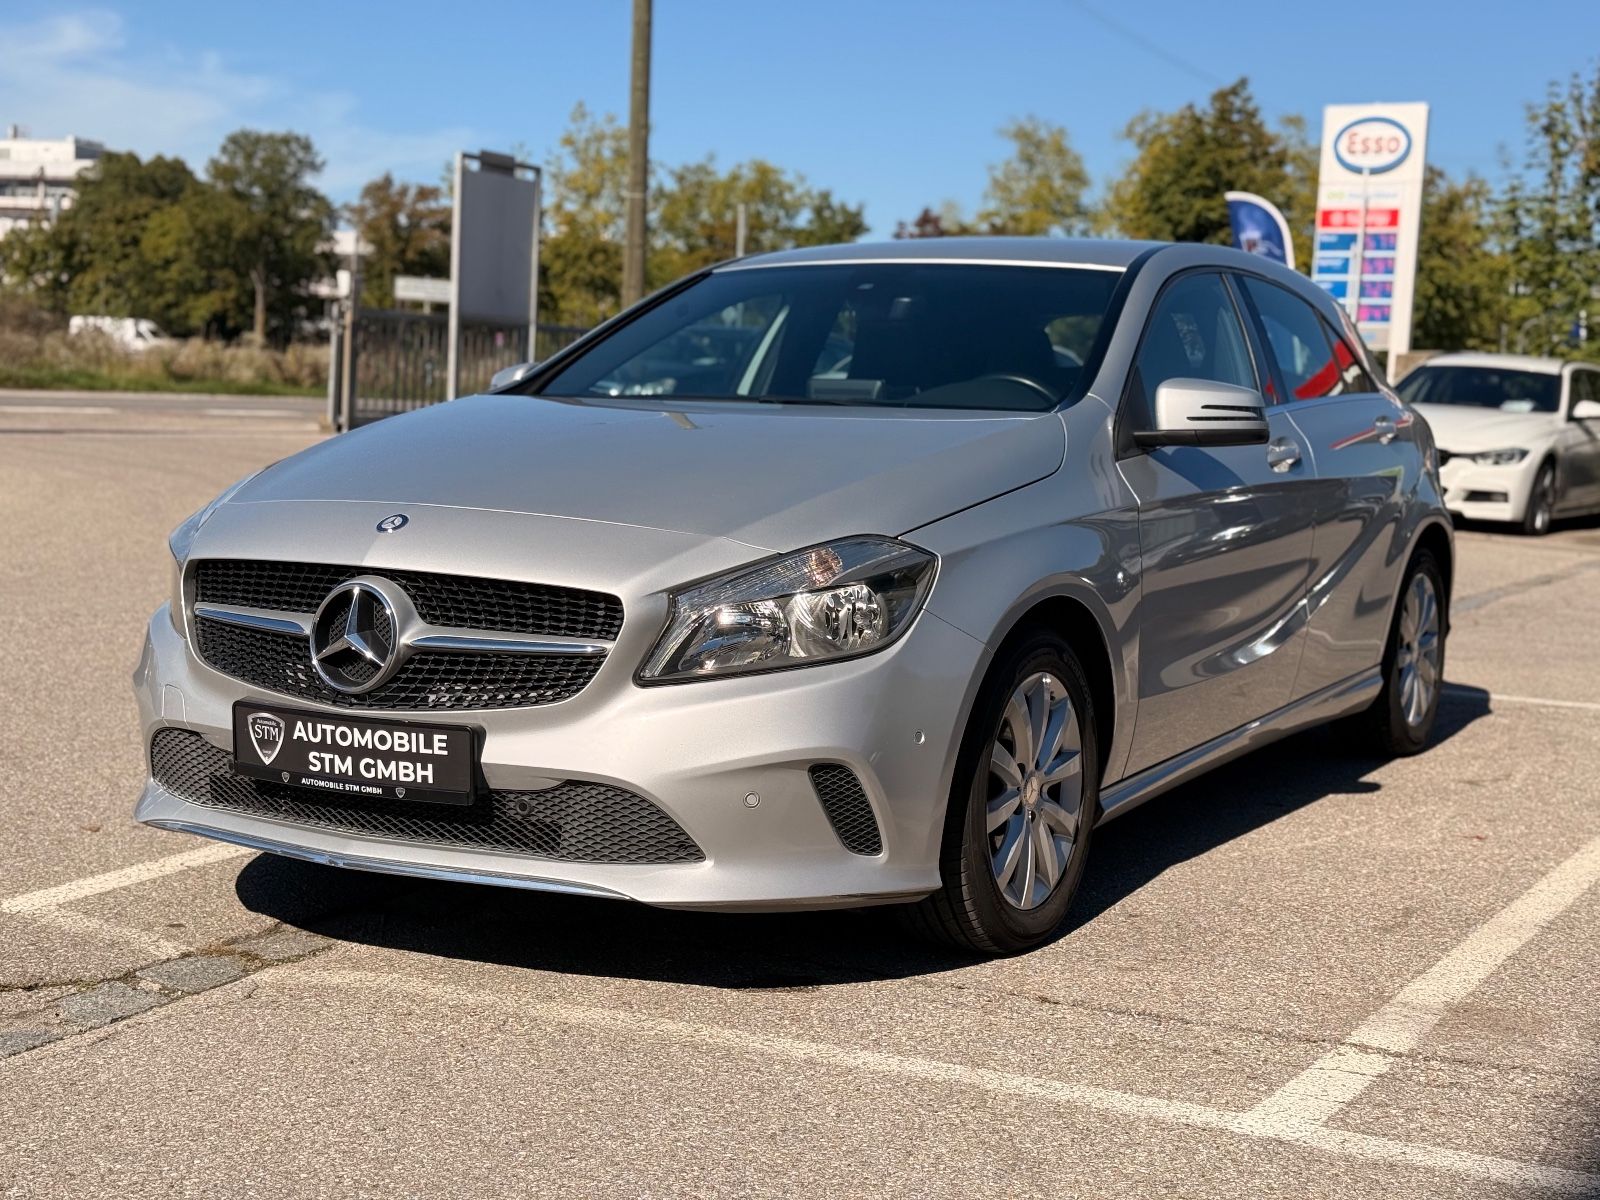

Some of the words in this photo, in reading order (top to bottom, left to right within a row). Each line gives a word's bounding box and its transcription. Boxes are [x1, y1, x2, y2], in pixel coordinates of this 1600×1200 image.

[254, 724, 279, 742] STM
[293, 720, 448, 755] AUTOMOBILE
[308, 751, 353, 776] STM
[359, 757, 434, 784] GMBH
[301, 777, 344, 790] AUTOMOBILE
[345, 783, 360, 792] STM
[361, 785, 383, 794] GMBH
